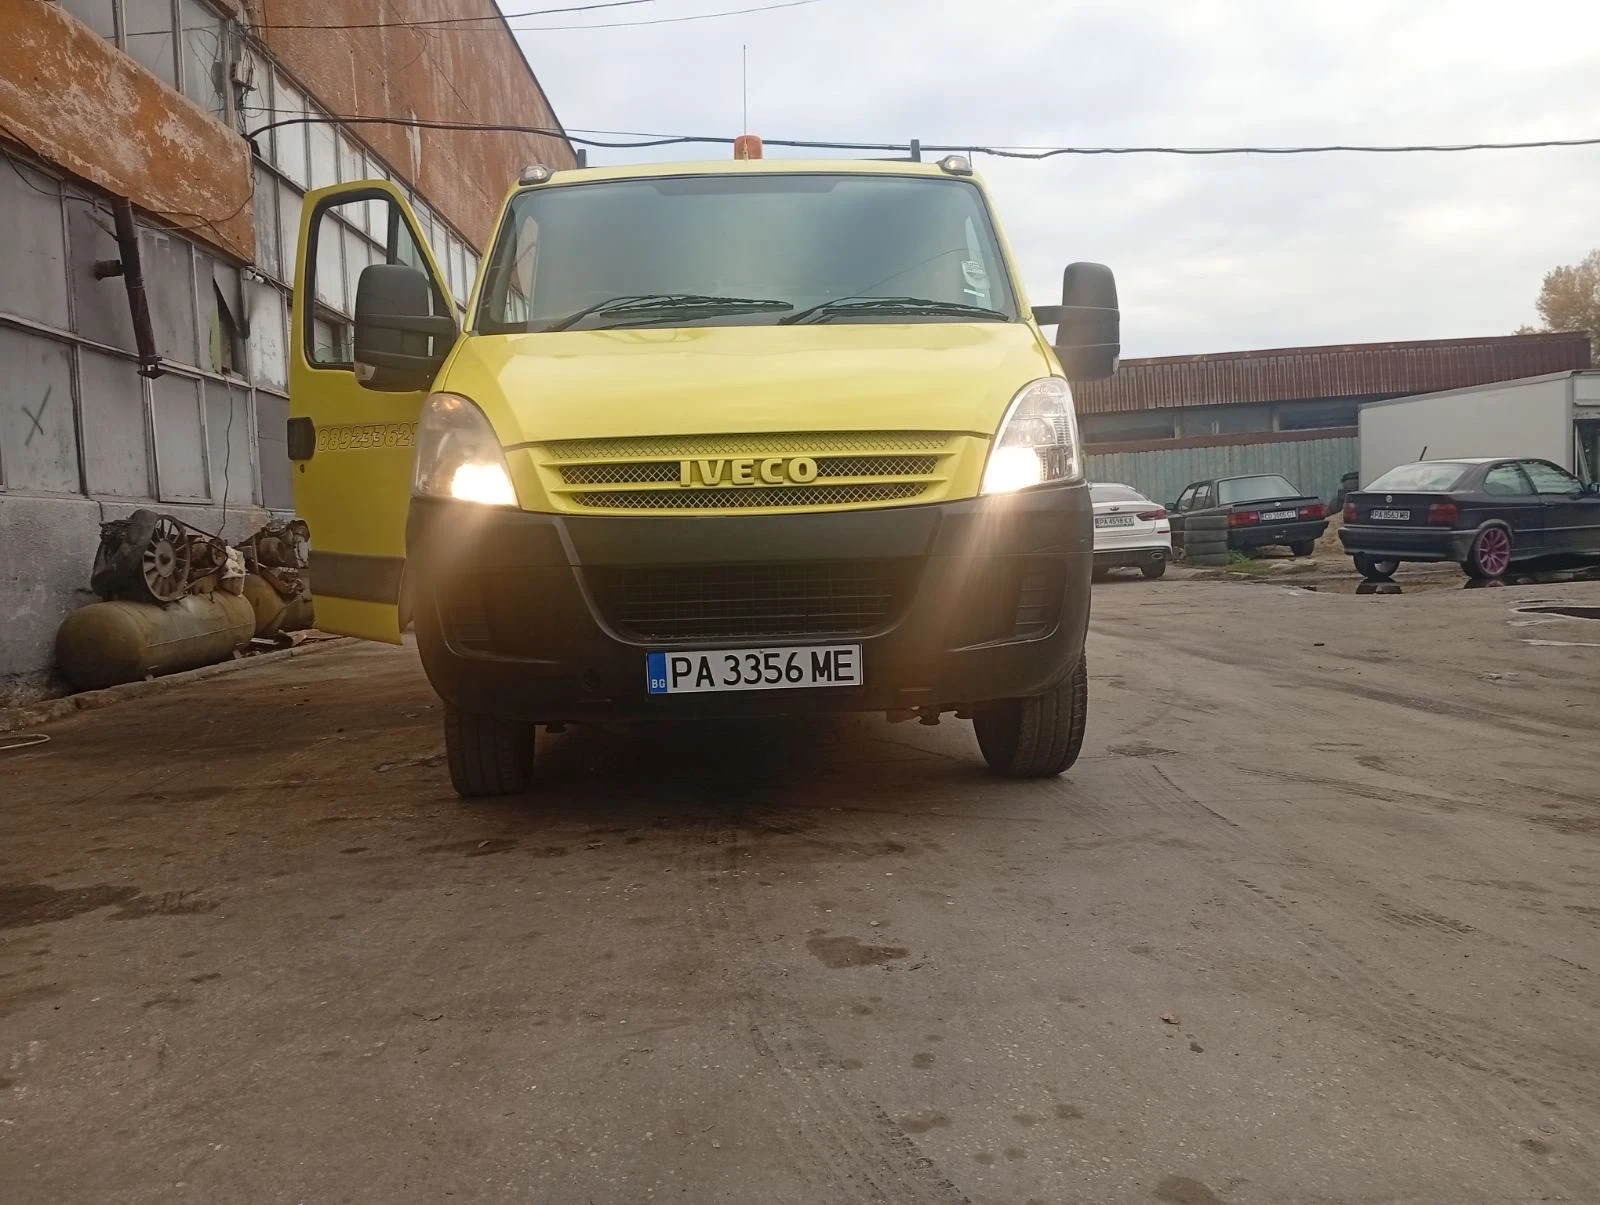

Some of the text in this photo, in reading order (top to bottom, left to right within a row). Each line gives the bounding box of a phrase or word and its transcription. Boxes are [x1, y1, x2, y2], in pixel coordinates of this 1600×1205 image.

[680, 457, 818, 487] IVECO
[1374, 510, 1383, 518] PA
[671, 650, 854, 688] PA 3356 ME
[651, 679, 666, 689] BG
